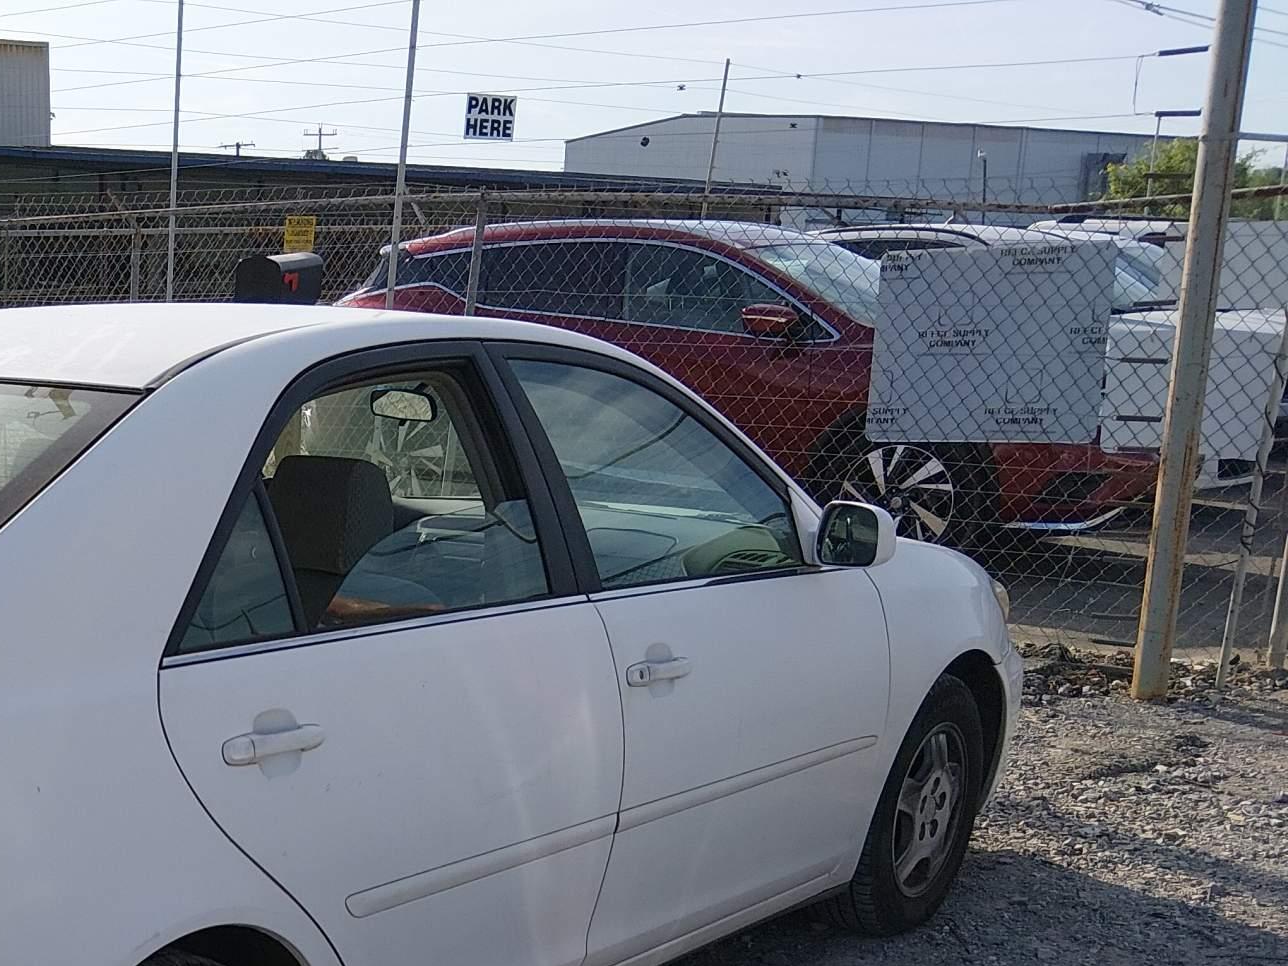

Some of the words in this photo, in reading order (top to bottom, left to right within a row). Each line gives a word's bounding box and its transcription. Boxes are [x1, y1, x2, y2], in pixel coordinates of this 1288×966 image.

[467, 96, 516, 117] PARK
[465, 117, 513, 138] HERE
[1012, 257, 1062, 266] COMPANY
[929, 340, 977, 348] COMPANY
[995, 417, 1044, 425] COMPANY
